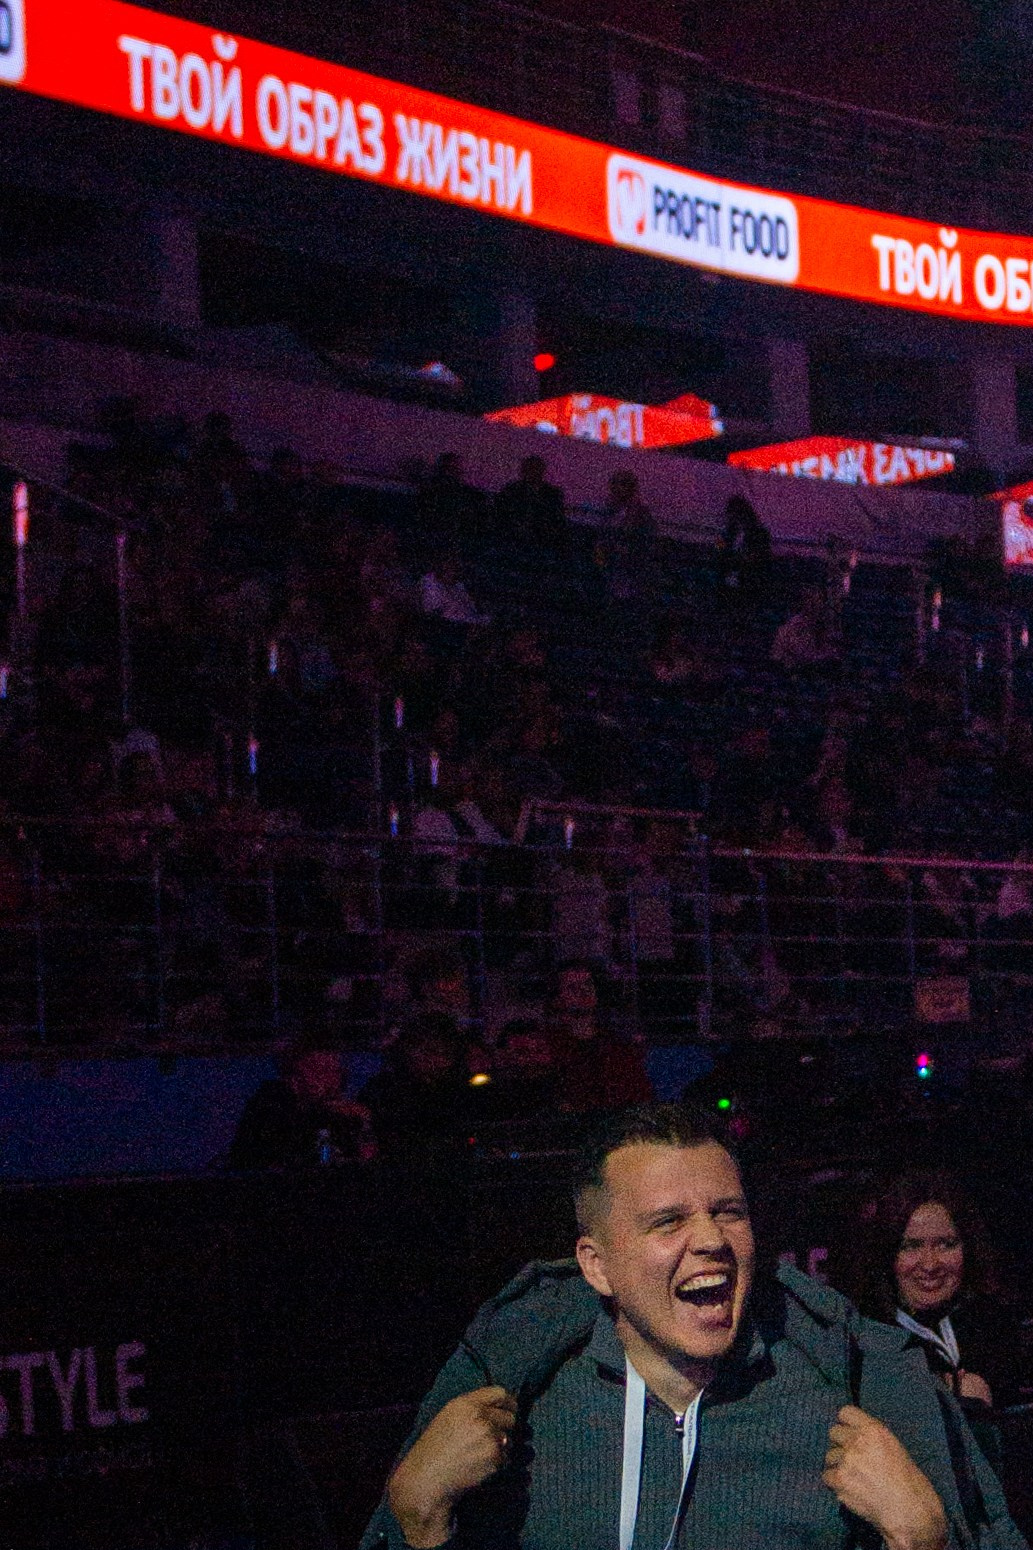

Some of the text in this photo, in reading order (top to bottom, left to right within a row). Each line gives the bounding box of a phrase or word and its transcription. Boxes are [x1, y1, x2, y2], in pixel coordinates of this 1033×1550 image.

[119, 34, 532, 215] ТВОЙ ОБРАЗ ЖИЗНИ
[654, 185, 788, 260] PROFIT FOOD
[871, 227, 962, 304] ТВОЙ
[0, 1341, 149, 1439] TYLE
